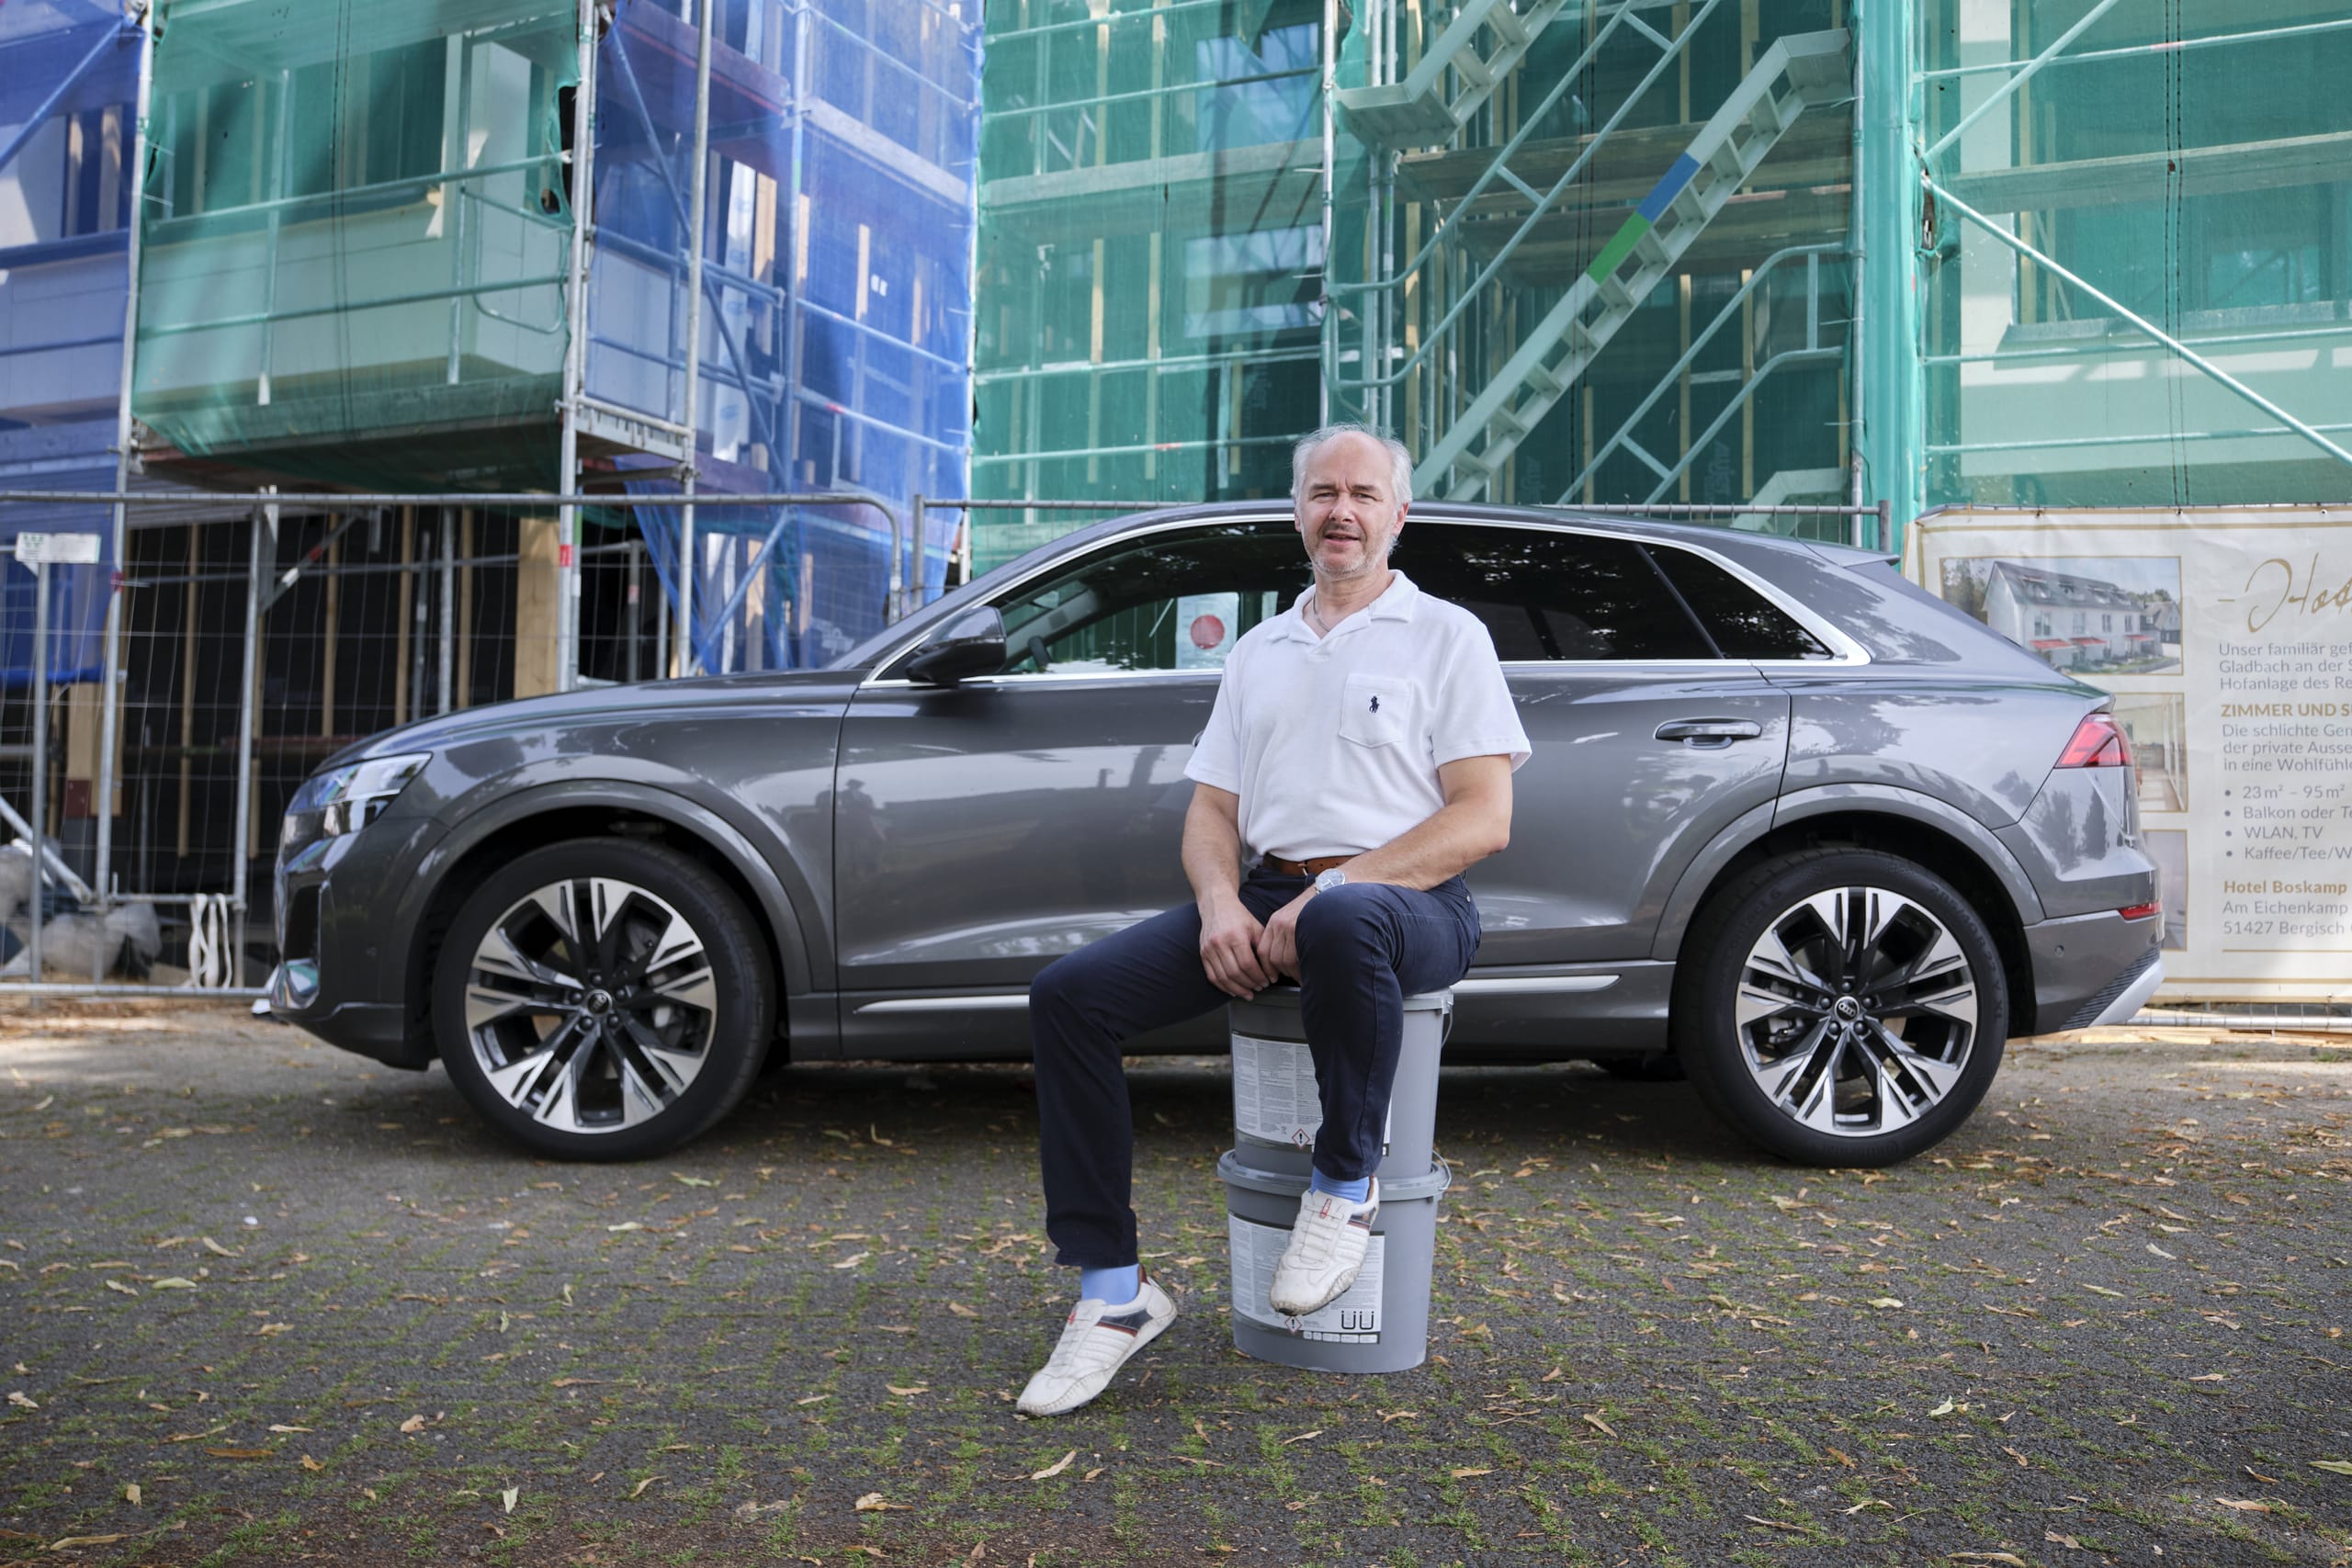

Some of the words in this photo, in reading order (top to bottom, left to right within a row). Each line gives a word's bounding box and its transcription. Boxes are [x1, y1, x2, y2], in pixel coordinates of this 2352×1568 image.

[2219, 643, 2263, 656] Unser
[2268, 643, 2325, 655] familiär
[2219, 660, 2290, 673] Gladbach
[2295, 663, 2312, 672] an
[2318, 659, 2343, 671] der
[2220, 677, 2299, 692] Hofanlage
[2303, 676, 2329, 689] des
[2221, 704, 2294, 717] ZIMMER
[2298, 704, 2336, 716] UND
[2340, 703, 2352, 716] S
[2222, 724, 2248, 737] Die
[2253, 723, 2319, 736] schlichte
[2222, 741, 2247, 753] der
[2252, 741, 2303, 756] private
[2307, 740, 2352, 753] Ausse
[2223, 758, 2237, 771] in
[2242, 759, 2272, 772] eine
[2243, 806, 2296, 819] Balkon
[2301, 806, 2335, 819] oder
[2244, 826, 2298, 840] WLAN,
[2302, 826, 2324, 839] TV
[2223, 880, 2267, 894] Hotel
[2272, 880, 2347, 896] Boskamp
[2222, 900, 2248, 915] Am
[2254, 900, 2348, 917] Eichenkamp
[2223, 920, 2274, 935] 51427
[2279, 920, 2345, 937] Bergisch
